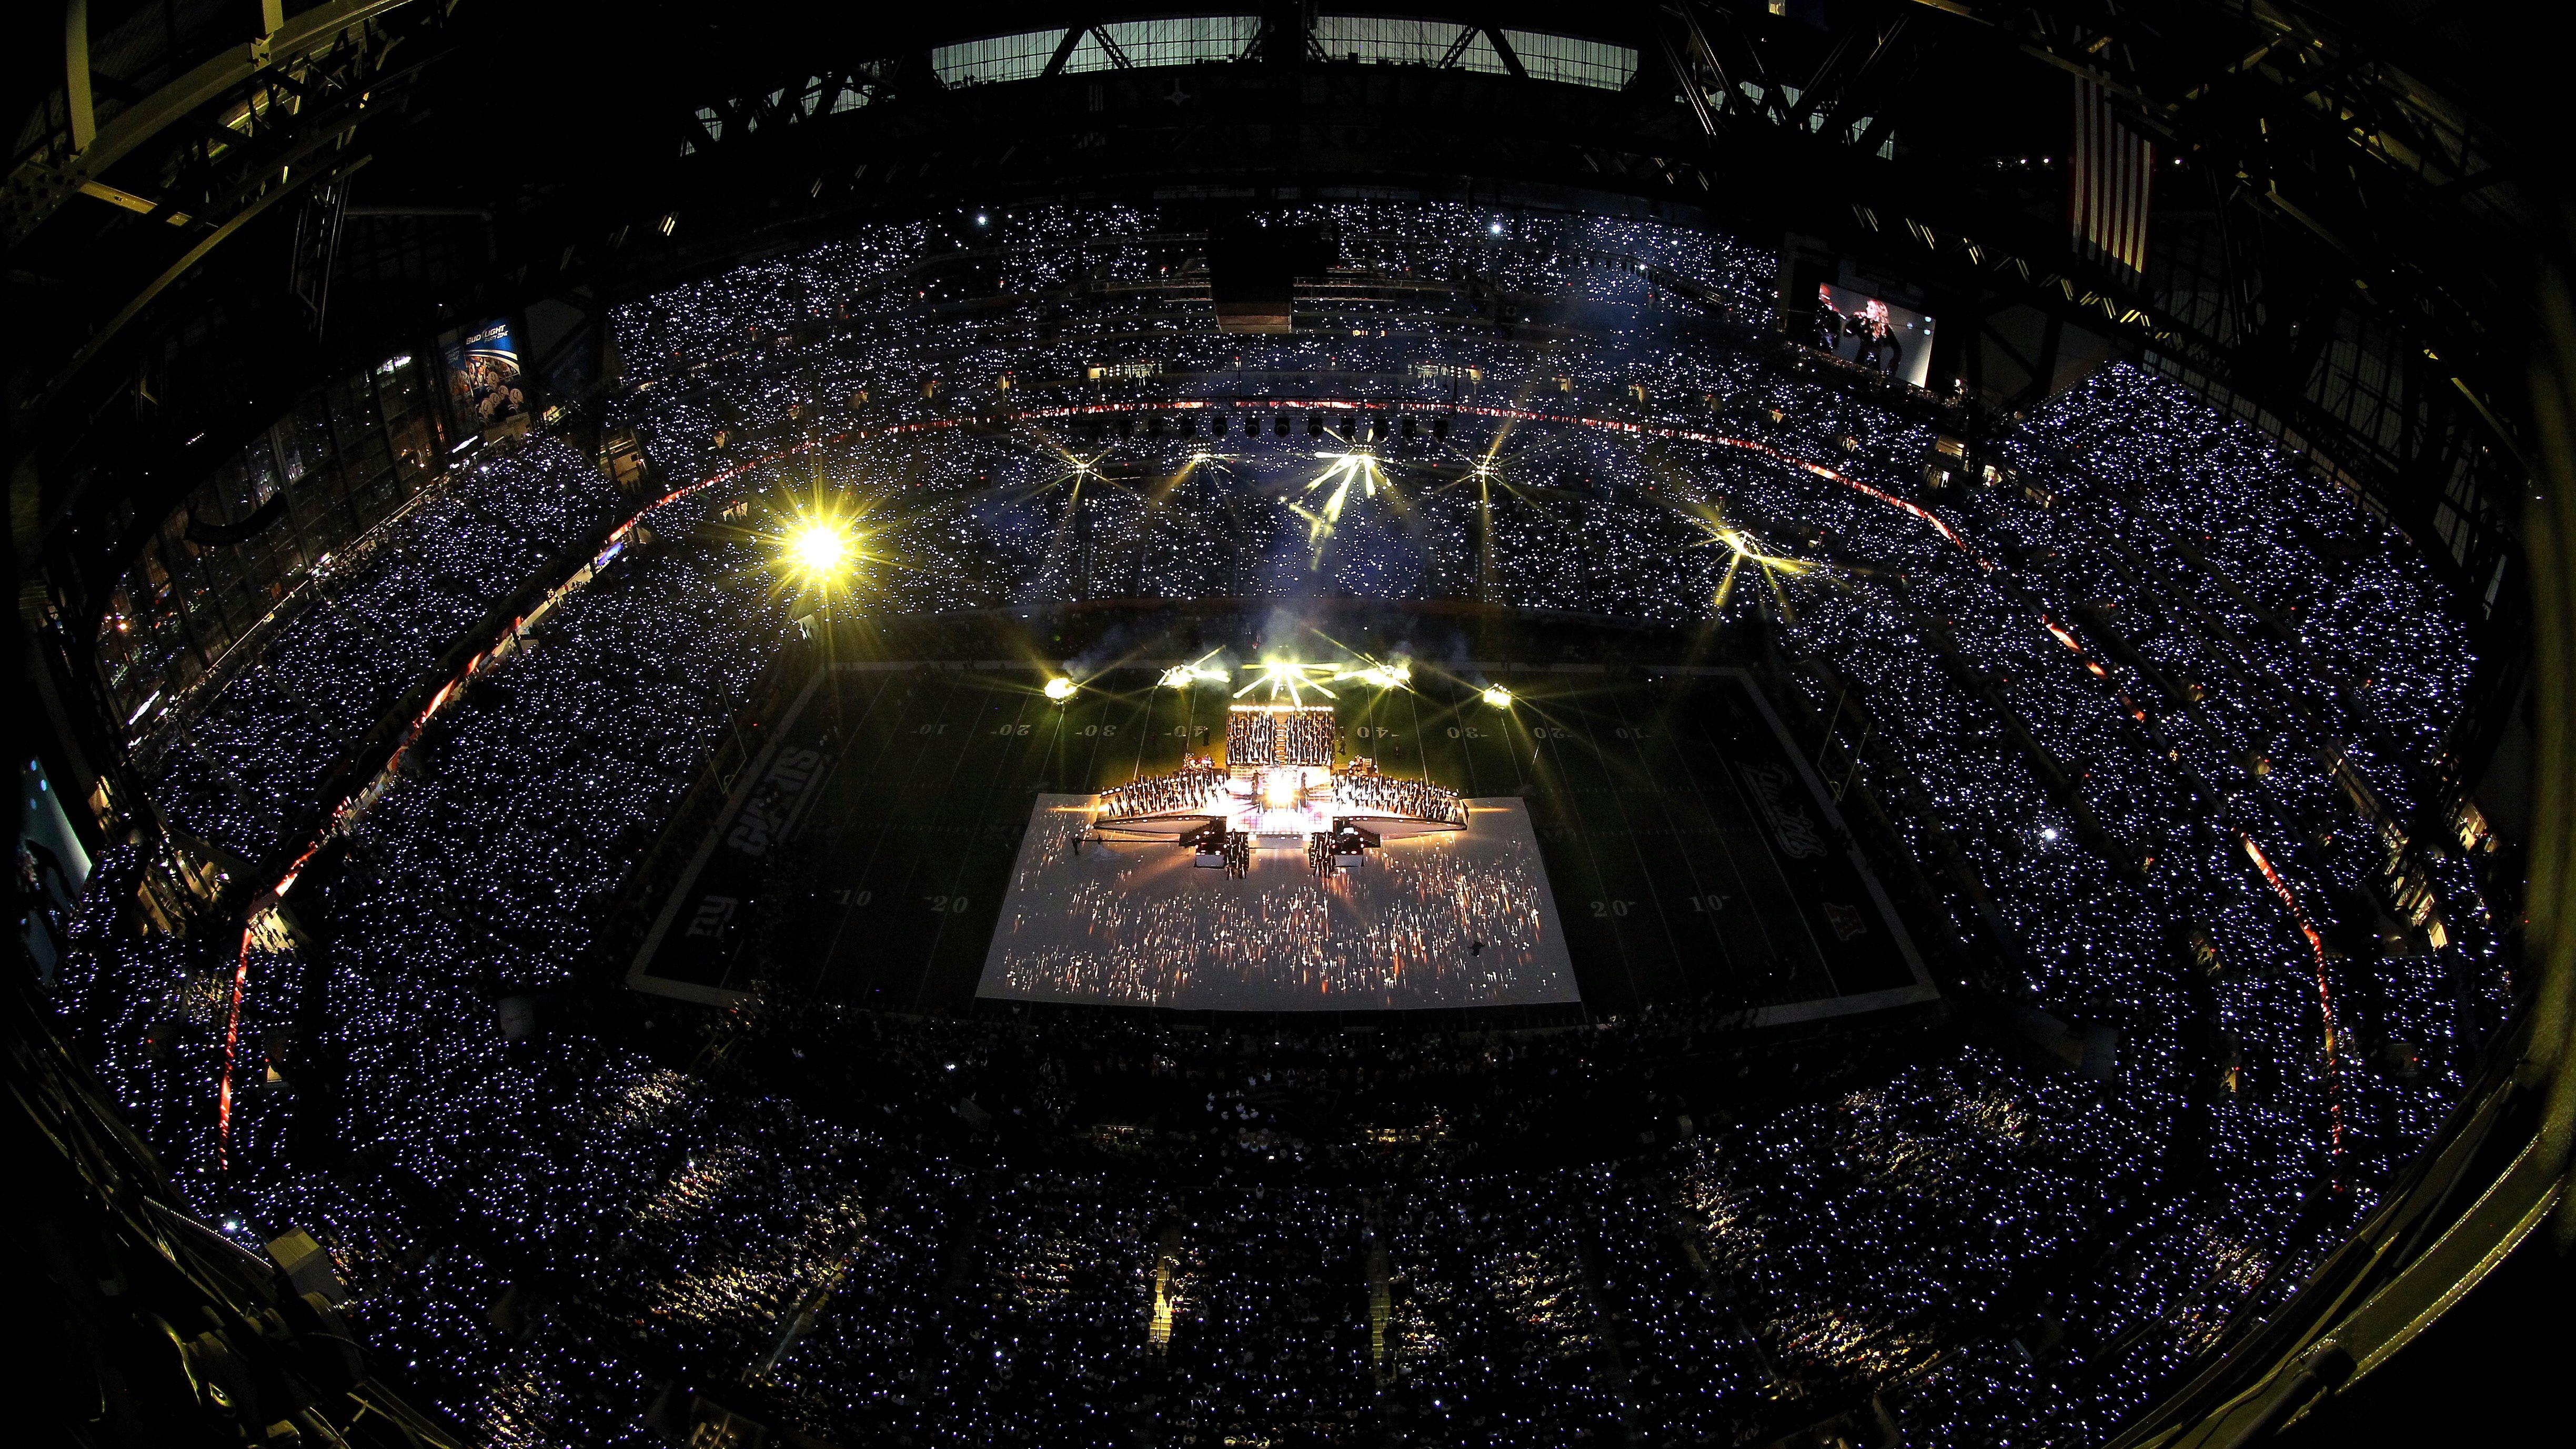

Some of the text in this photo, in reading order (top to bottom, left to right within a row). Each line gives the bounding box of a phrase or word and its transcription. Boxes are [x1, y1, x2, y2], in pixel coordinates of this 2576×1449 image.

[466, 324, 506, 345] BUD LIGHT
[1000, 724, 1031, 736] 20
[1084, 725, 1116, 737] 30
[1174, 726, 1205, 737] 40
[1357, 727, 1388, 738] 40
[1447, 727, 1478, 738] 30
[1534, 728, 1565, 739] 20
[838, 889, 872, 907] 10
[931, 895, 968, 913] 20
[1689, 895, 1723, 912] 10
[1590, 899, 1628, 918] 20
